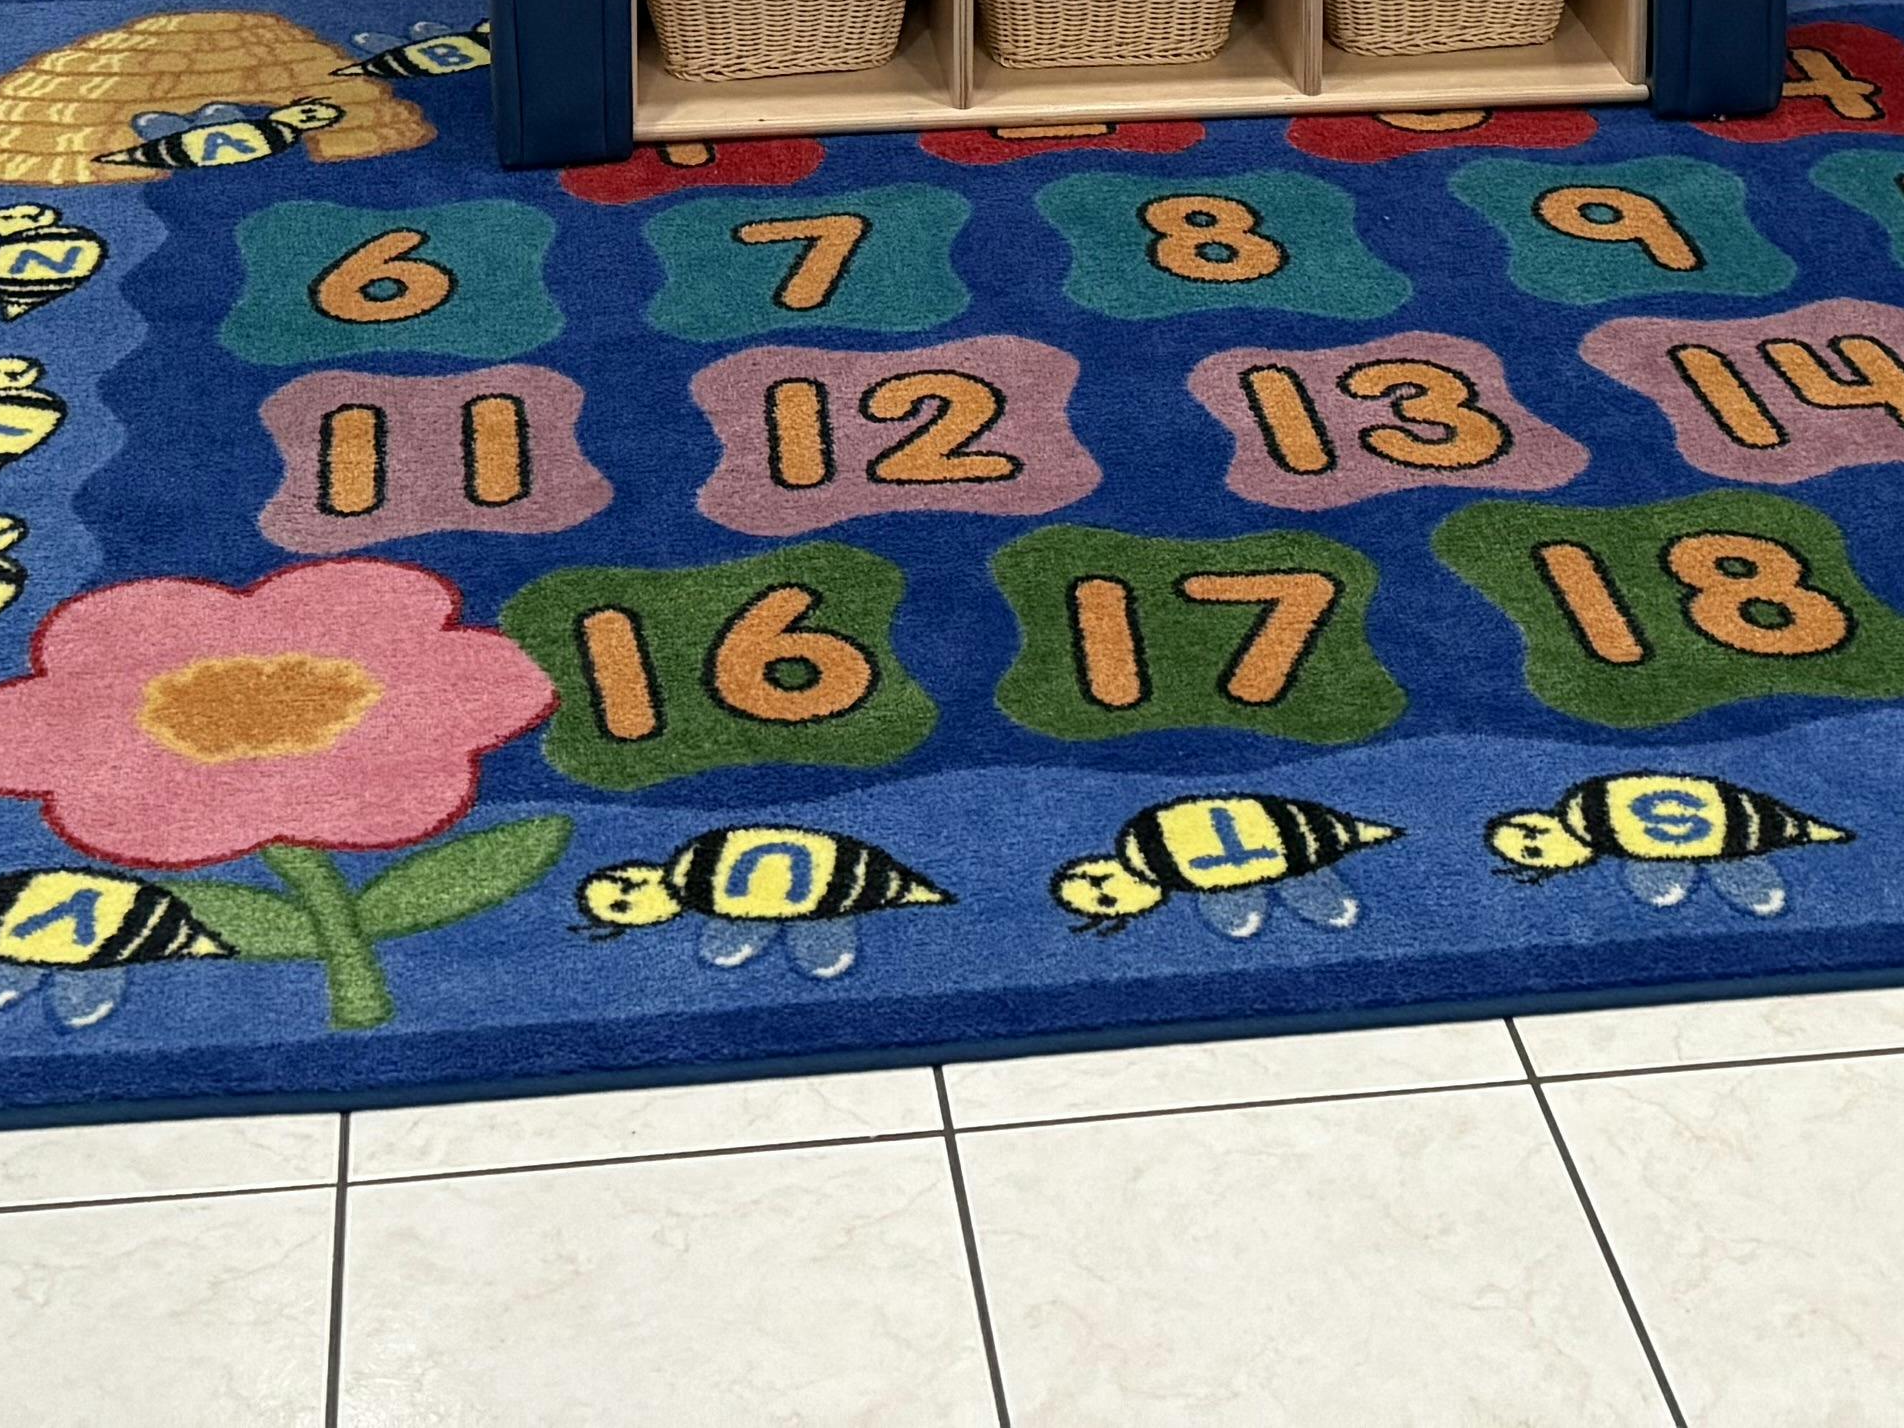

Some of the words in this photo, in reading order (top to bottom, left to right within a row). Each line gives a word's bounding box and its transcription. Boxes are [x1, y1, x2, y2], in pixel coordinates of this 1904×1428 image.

[417, 42, 475, 68] B
[1782, 47, 1884, 121] 4
[200, 130, 256, 162] A
[731, 212, 872, 311] 7
[1138, 193, 1290, 284] 8
[1532, 184, 1704, 272] 9
[310, 226, 458, 324] 6
[318, 392, 531, 517] 11
[764, 370, 1025, 491] 12
[1239, 359, 1515, 477] 13
[1067, 568, 1344, 711] 17
[1532, 529, 1855, 666] 18
[573, 583, 879, 742] 16
[1188, 806, 1282, 871] T
[1626, 787, 1715, 847] S
[12, 888, 101, 947] V
[724, 842, 815, 902] U
